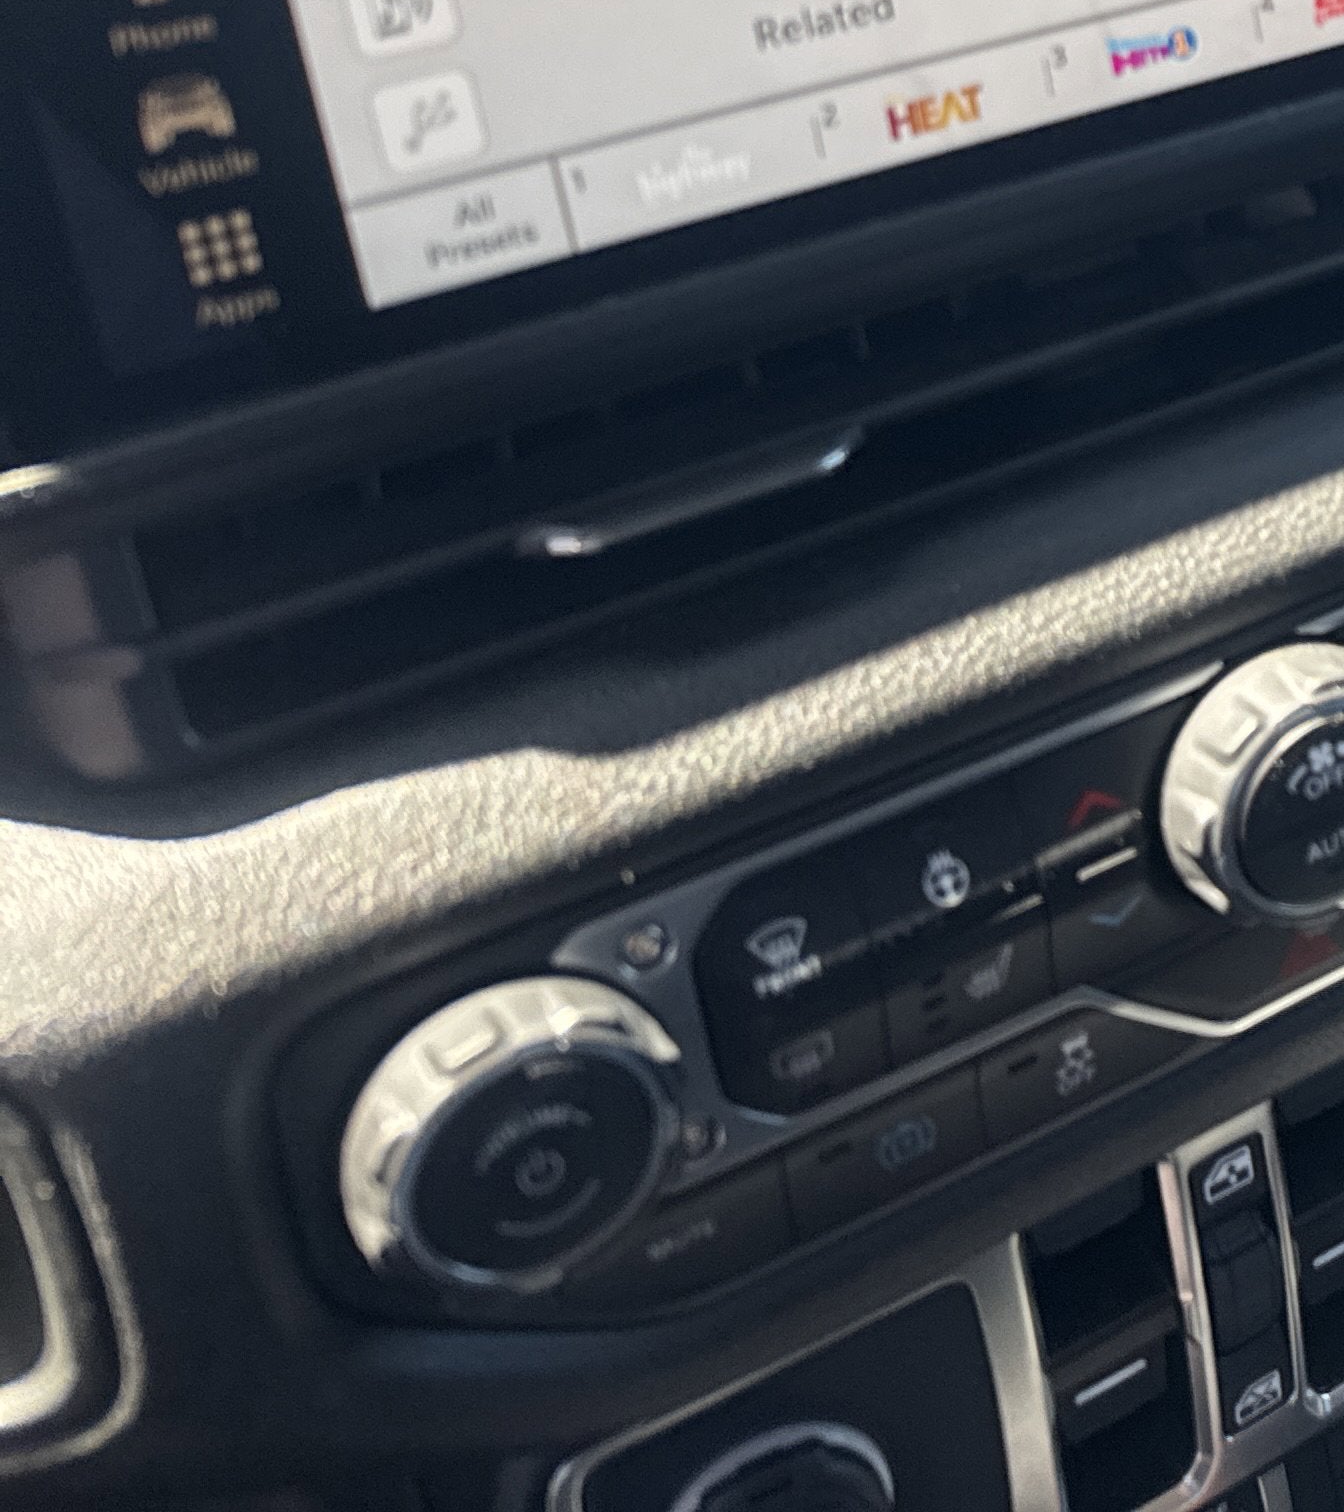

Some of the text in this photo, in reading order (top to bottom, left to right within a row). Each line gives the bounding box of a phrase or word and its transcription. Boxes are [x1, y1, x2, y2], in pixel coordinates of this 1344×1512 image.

[108, 14, 218, 57] Phone
[885, 84, 984, 143] HEAT
[138, 148, 259, 198] Vehicle
[454, 194, 496, 228] All
[425, 220, 540, 270] Presets
[195, 285, 280, 329] Apps
